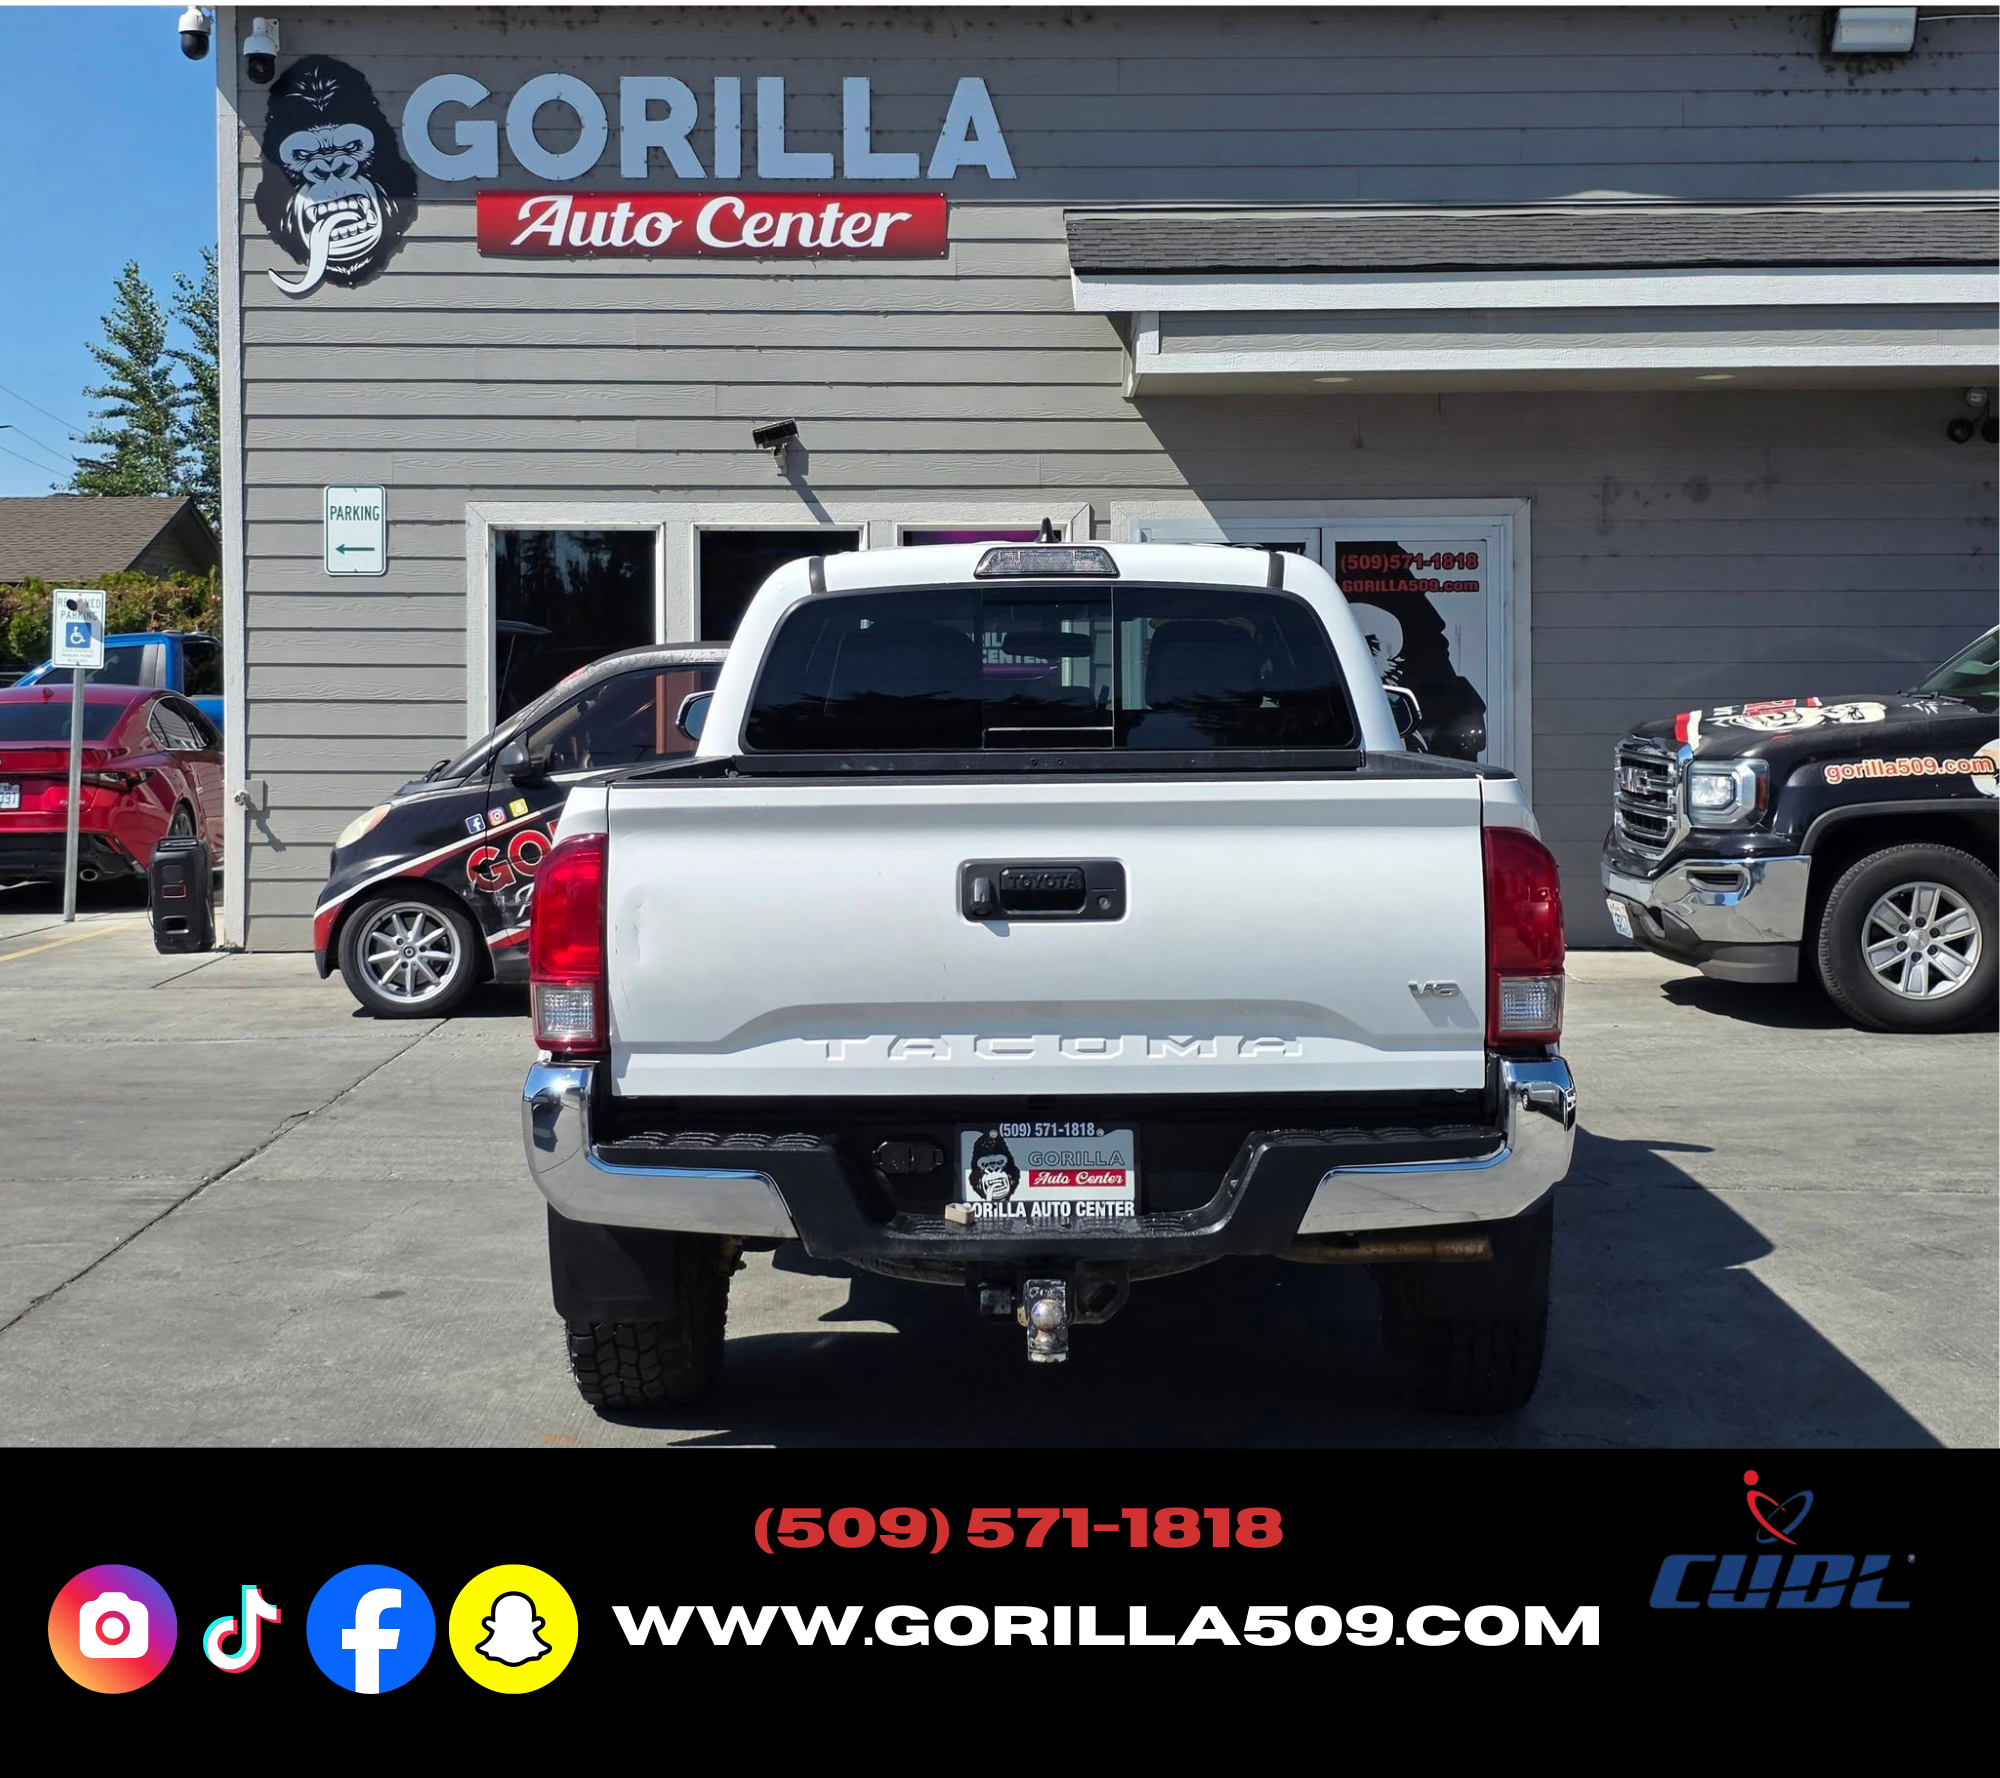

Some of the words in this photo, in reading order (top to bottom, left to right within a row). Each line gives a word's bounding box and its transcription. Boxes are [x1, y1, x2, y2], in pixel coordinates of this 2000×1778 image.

[402, 72, 1016, 181] GORILLA
[511, 195, 683, 247] Auto
[696, 195, 912, 249] Center
[330, 505, 380, 521] PARKING
[1340, 552, 1479, 573] (509)571-1818
[1342, 578, 1480, 593] GORILLA509.com
[58, 598, 101, 609] REVED
[61, 610, 98, 621] PARKING
[1825, 756, 1995, 784] gorilla509.com
[466, 818, 560, 893] GO
[1008, 873, 1078, 889] TOYOTA
[1408, 980, 1460, 998] V6
[803, 1034, 1303, 1062] TACOMA
[999, 1122, 1031, 1138] (509)
[1035, 1122, 1095, 1137] 571-1818
[1028, 1151, 1126, 1167] GORILLA
[1033, 1171, 1070, 1186] Auto
[1075, 1171, 1125, 1186] Center
[1031, 1201, 1071, 1218] AUTO
[1075, 1201, 1135, 1218] CENTER
